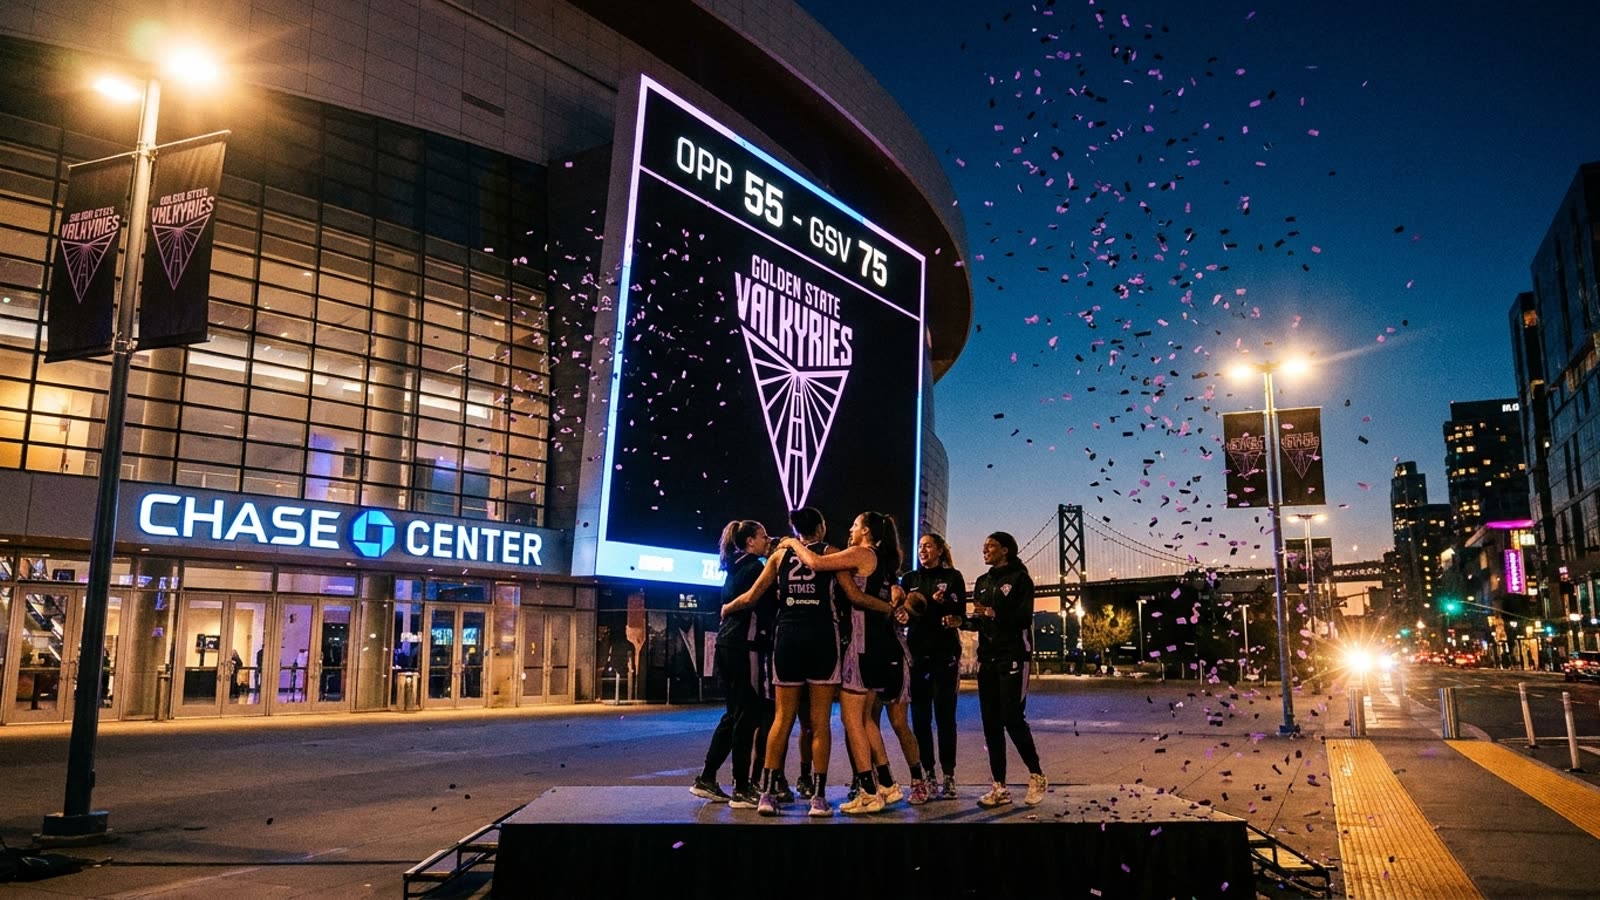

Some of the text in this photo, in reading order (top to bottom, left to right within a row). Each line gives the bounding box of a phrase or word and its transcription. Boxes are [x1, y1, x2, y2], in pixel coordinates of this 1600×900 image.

[676, 136, 888, 288] OPP 55 - GSV 75
[734, 271, 853, 367] VALKYRIES
[751, 254, 841, 320] GOLDEN STATE
[139, 493, 542, 566] CHASE CENTER
